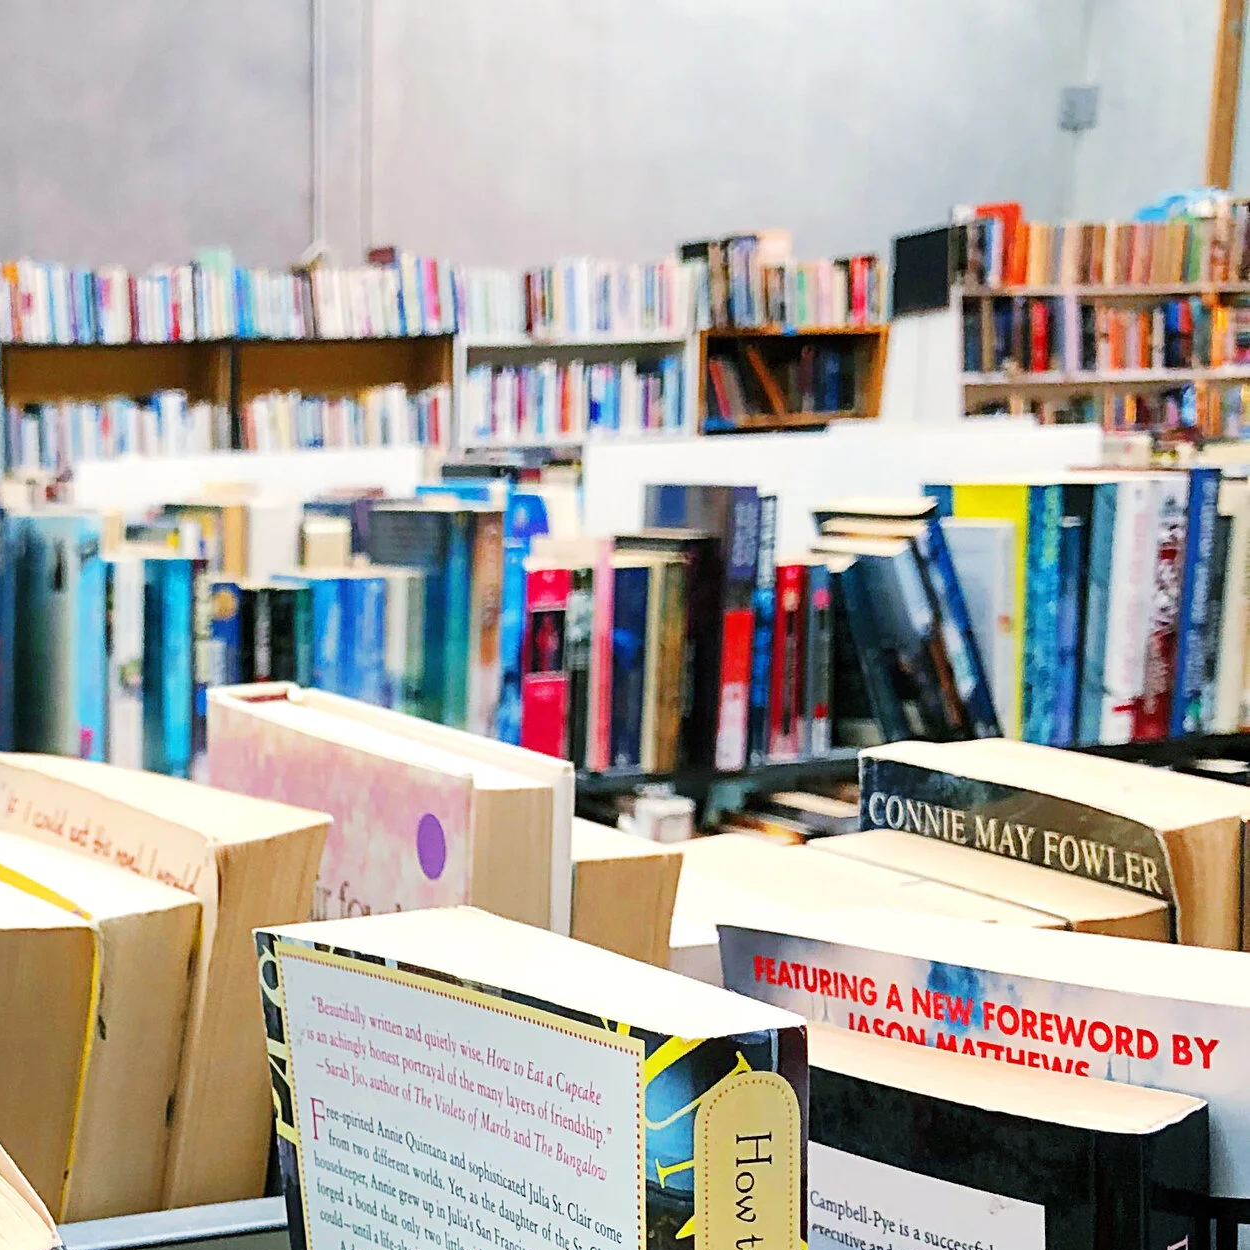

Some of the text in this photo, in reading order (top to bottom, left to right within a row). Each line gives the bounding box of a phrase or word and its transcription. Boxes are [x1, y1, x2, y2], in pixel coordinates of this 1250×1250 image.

[869, 793, 1164, 894] CONNIE MAY FOWLER
[368, 1012, 402, 1036] written
[404, 1023, 422, 1042] and
[424, 1029, 456, 1058] quietly
[459, 1039, 484, 1066] wise,
[486, 1047, 511, 1072] How
[513, 1061, 524, 1076] to
[526, 1060, 543, 1084] Eat
[546, 1075, 552, 1087] a
[555, 1071, 601, 1105] Cupcake
[753, 955, 1219, 1069] FEATURING A NEW FOREWORD BY
[306, 1029, 314, 1040] is
[316, 1031, 327, 1044] an
[329, 1030, 366, 1060] achingly
[368, 1039, 399, 1066] honest
[401, 1056, 445, 1083] portrayal
[446, 1067, 456, 1086] of
[459, 1070, 474, 1092] the
[476, 1083, 503, 1107] many
[505, 1085, 535, 1116] layers
[537, 1100, 547, 1120] of
[369, 1074, 399, 1096] author
[401, 1082, 411, 1101] of
[413, 1086, 431, 1108] The
[434, 1093, 465, 1122] Violets
[467, 1107, 478, 1130] of
[480, 1111, 510, 1139] March
[513, 1128, 530, 1148] and
[533, 1131, 552, 1157] The
[555, 1142, 607, 1181] Bungalow
[328, 1128, 349, 1151] from
[352, 1142, 369, 1159] two
[372, 1145, 409, 1175] different
[412, 1167, 445, 1190] worlds.
[447, 1176, 466, 1202] Yet,
[469, 1191, 478, 1205] as
[480, 1191, 495, 1213] the
[498, 1199, 538, 1234] daughter
[541, 1222, 551, 1241] of
[554, 1227, 569, 1250] the
[370, 1173, 396, 1197] Annie
[398, 1189, 419, 1206] grew
[422, 1199, 434, 1218] up
[436, 1201, 445, 1219] in
[447, 1205, 473, 1232] Julia's
[475, 1218, 491, 1241] San
[377, 1120, 403, 1144] Annie
[405, 1130, 447, 1162] Quintana
[449, 1151, 466, 1170] and
[468, 1160, 526, 1197] sophisticated
[528, 1182, 550, 1209] Julia
[552, 1194, 564, 1215] St.
[567, 1202, 591, 1229] Clair
[594, 1221, 621, 1244] come
[735, 1132, 772, 1223] How
[810, 1190, 895, 1234] Campbell-Pye
[900, 1219, 909, 1237] is
[913, 1228, 920, 1241] a
[811, 1222, 866, 1250] executive
